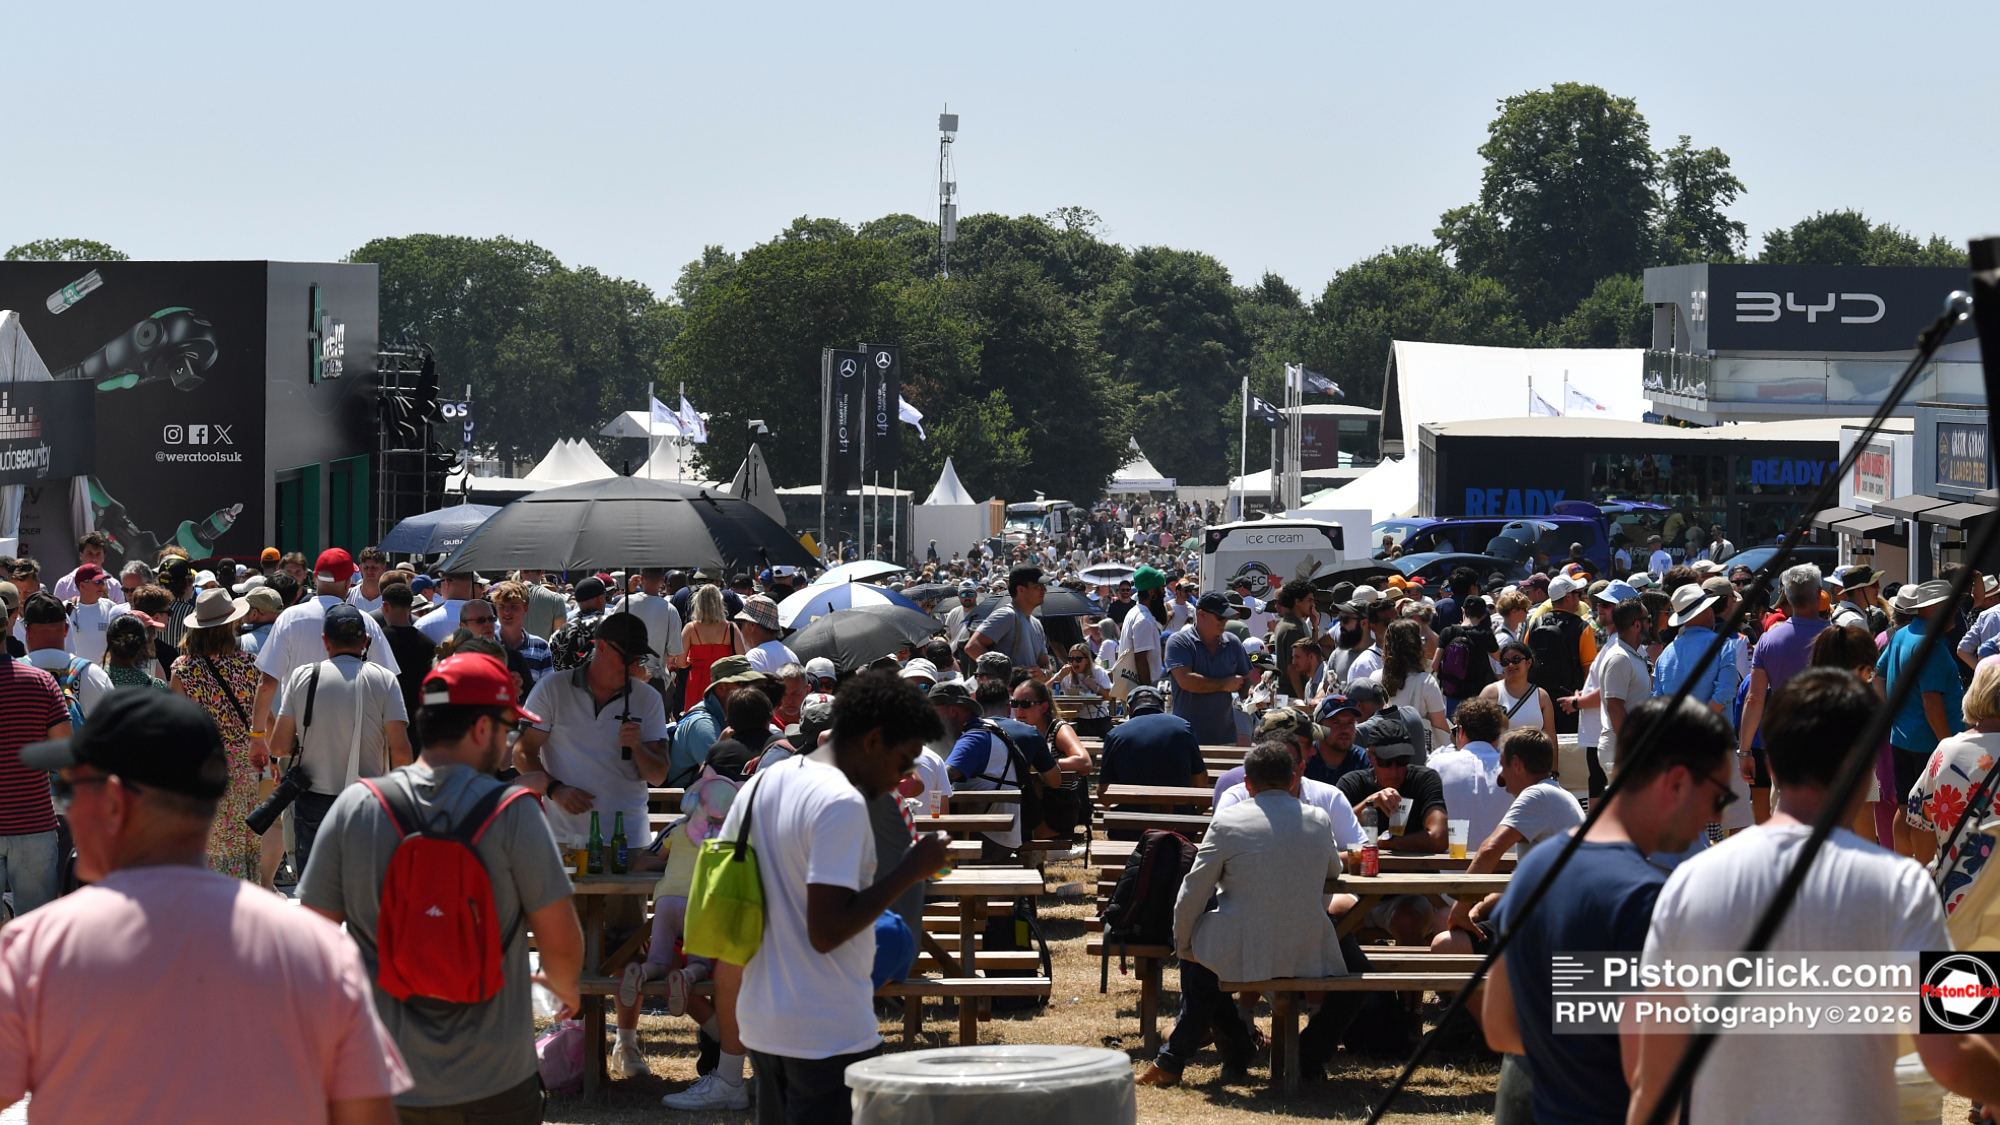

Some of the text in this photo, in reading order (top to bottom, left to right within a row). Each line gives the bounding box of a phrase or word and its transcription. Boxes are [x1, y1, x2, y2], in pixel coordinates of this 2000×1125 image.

[1736, 292, 1885, 323] BYD
[442, 403, 468, 417] OS
[876, 412, 889, 437] 140
[839, 427, 850, 453] 140
[155, 451, 242, 462] @weratoolsuk
[1751, 460, 1825, 486] READY
[1465, 487, 1565, 517] READY
[20, 527, 41, 535] CKER
[1245, 533, 1304, 544] ice cream
[1246, 575, 1266, 586] EC
